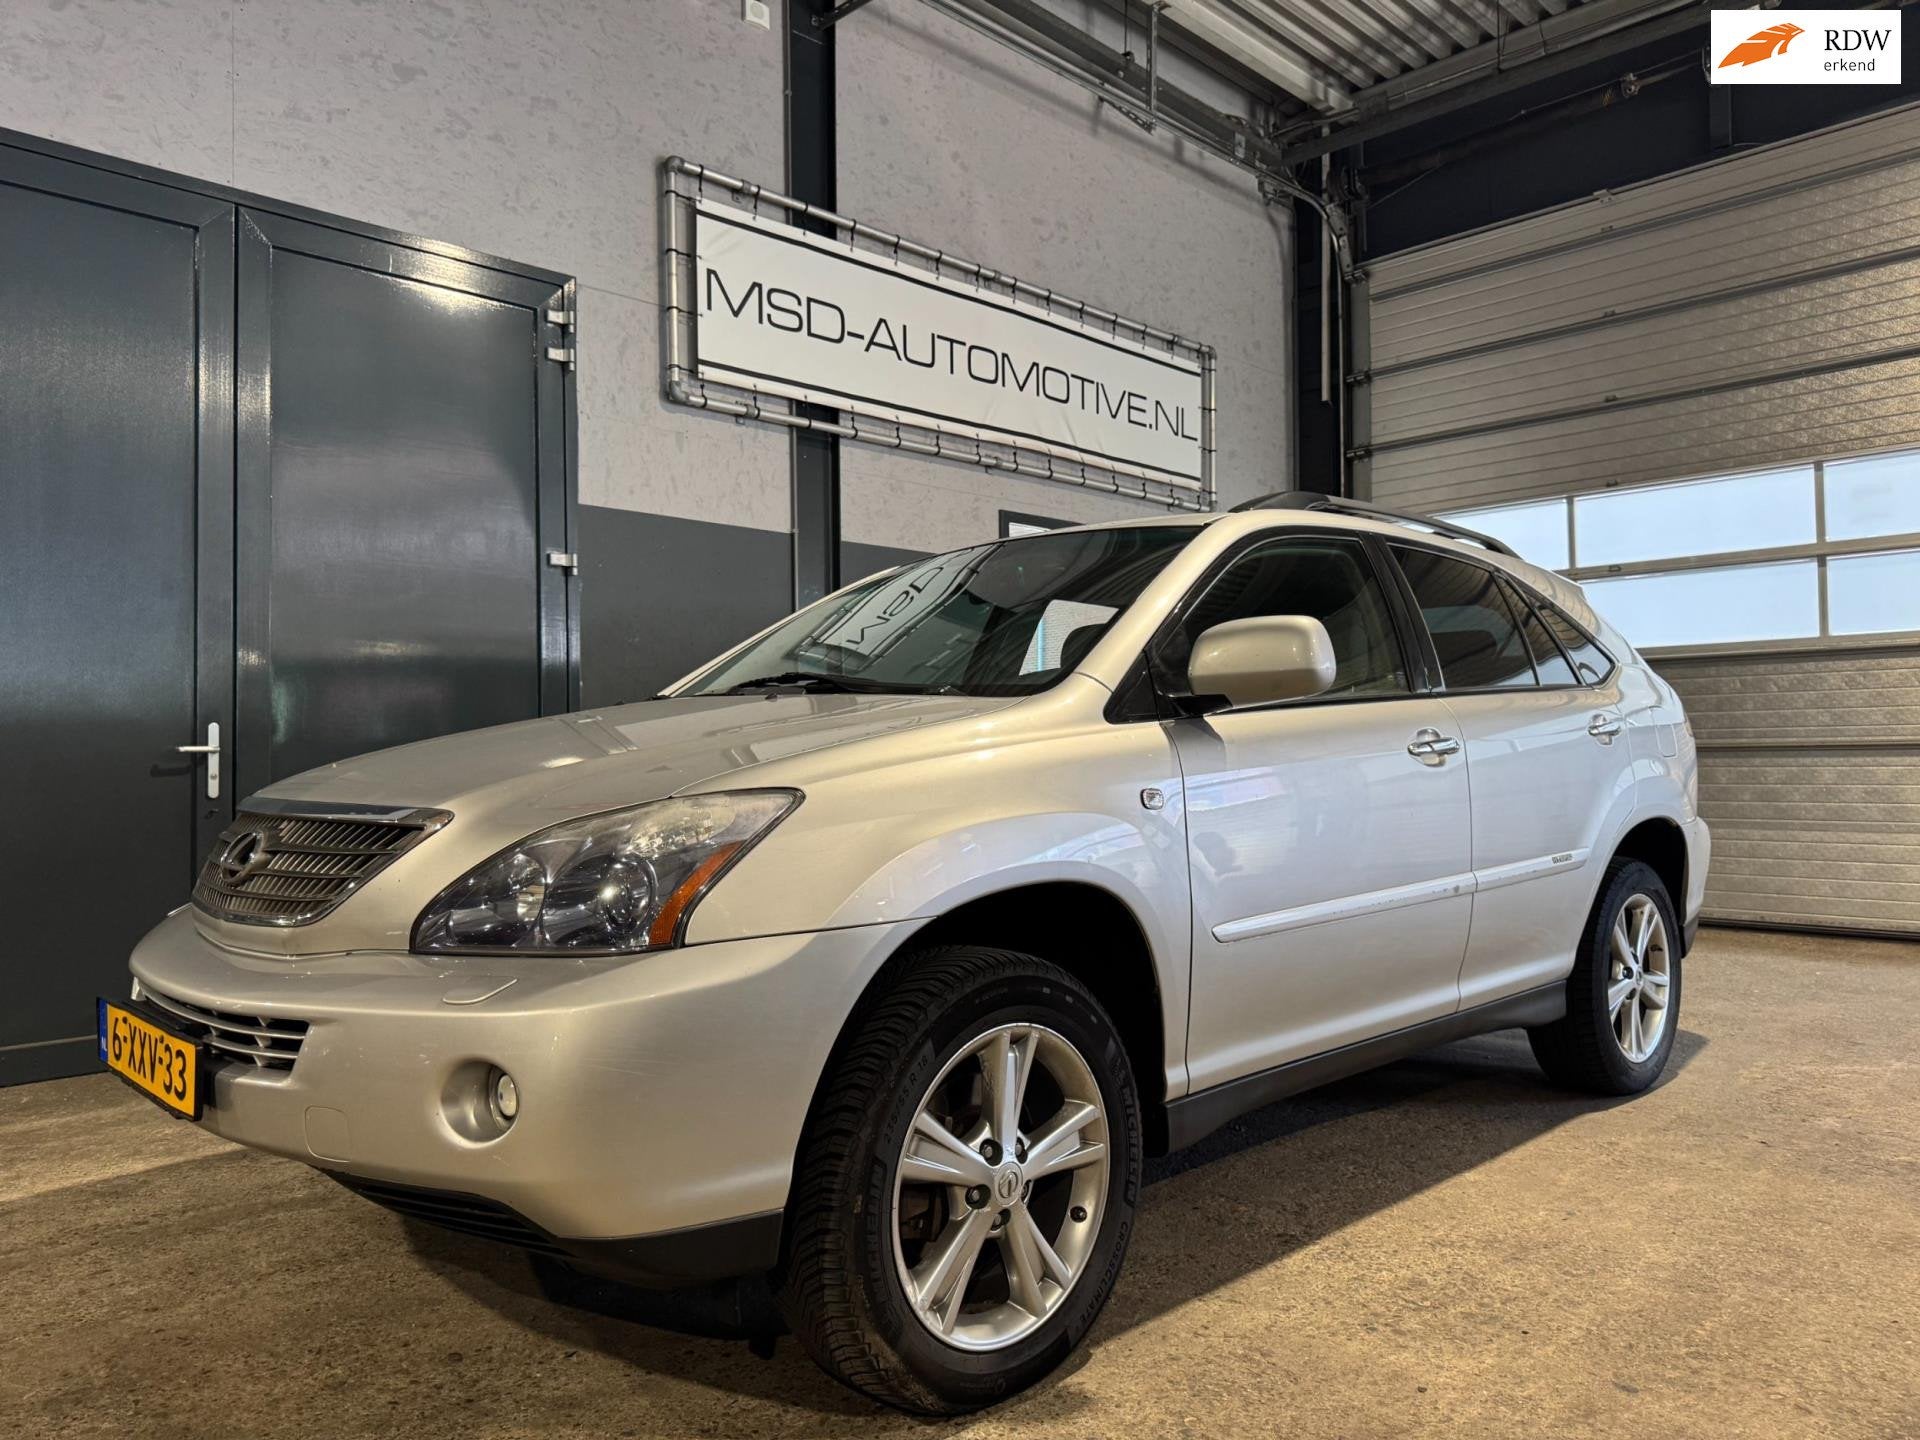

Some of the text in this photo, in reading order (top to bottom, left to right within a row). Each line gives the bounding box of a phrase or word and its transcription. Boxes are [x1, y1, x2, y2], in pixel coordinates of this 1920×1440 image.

[705, 268, 1198, 442] MSD-AUTOMOTIVE.NL
[101, 1037, 108, 1052] NL
[112, 1017, 187, 1102] 6-XXV-33
[1121, 1086, 1139, 1202] MICHELIN
